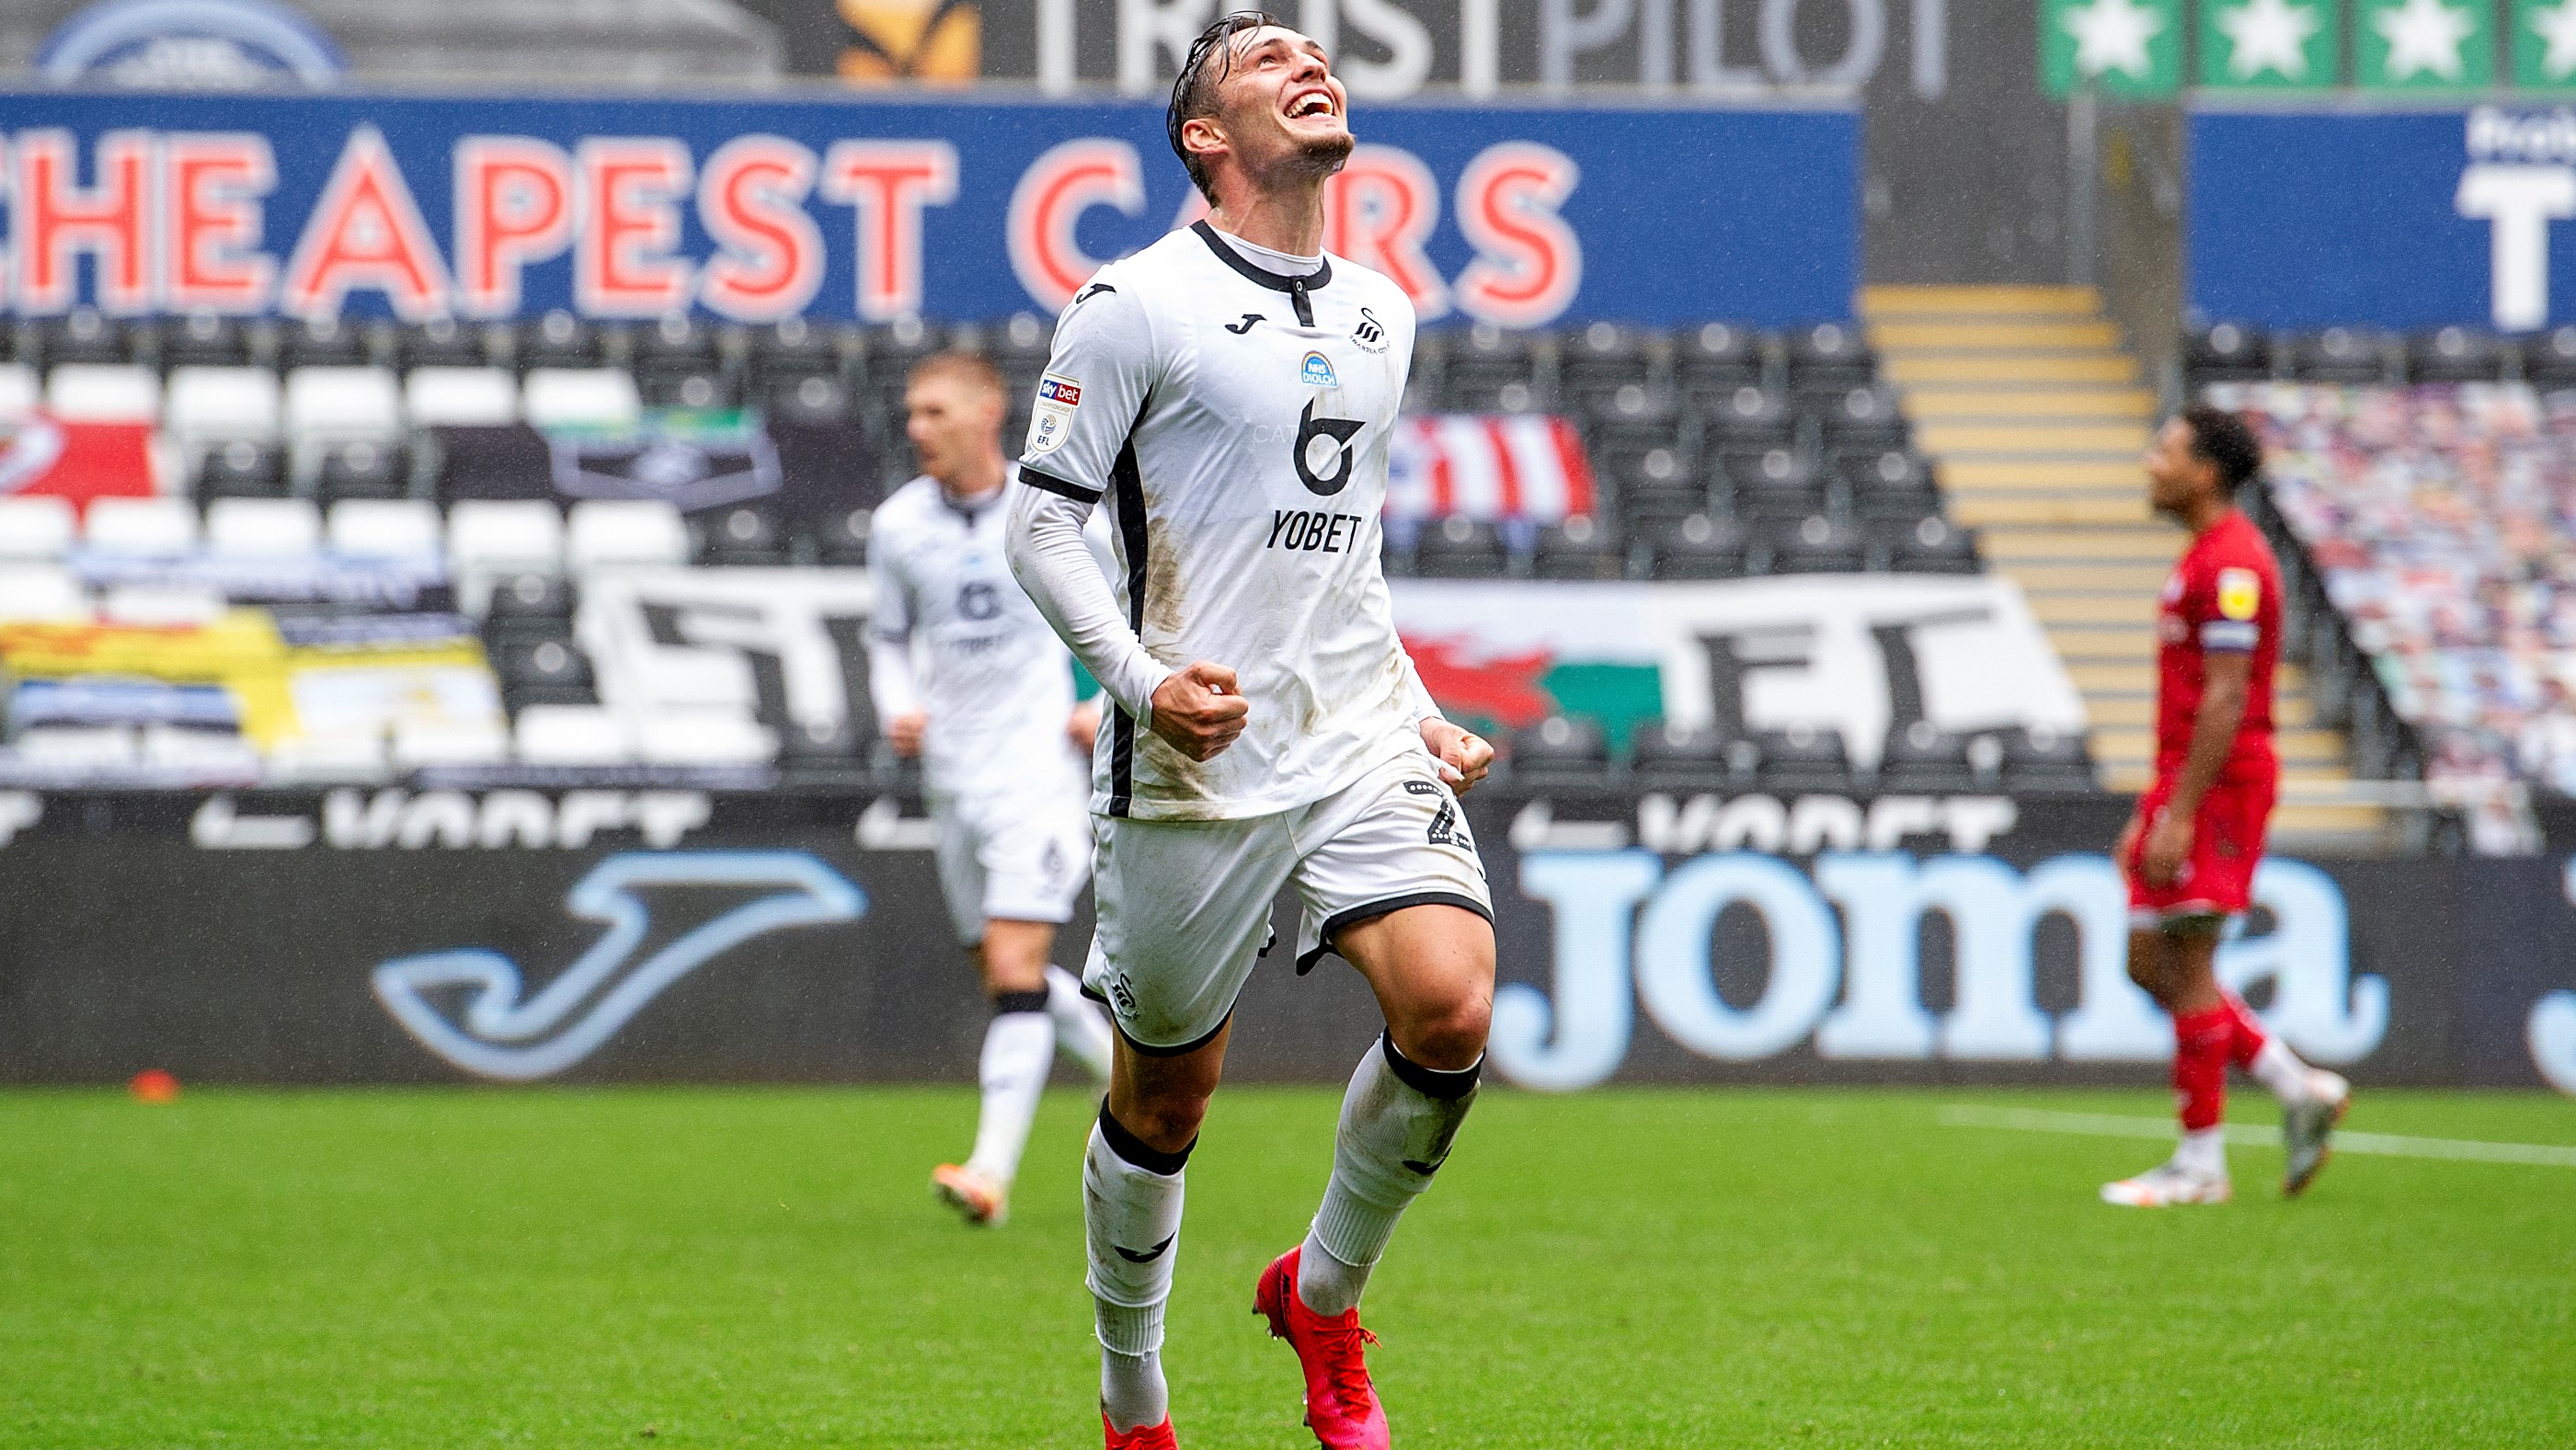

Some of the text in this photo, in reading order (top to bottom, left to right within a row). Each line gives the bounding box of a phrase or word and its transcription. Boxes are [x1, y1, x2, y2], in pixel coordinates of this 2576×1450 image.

[0, 123, 1584, 328] HEAPEST CRS
[1308, 363, 1326, 374] NHS
[1302, 371, 1336, 385] DIOLCH
[1041, 381, 1078, 402] sky bet
[1036, 435, 1049, 446] EFL
[1266, 509, 1362, 554] YOBET
